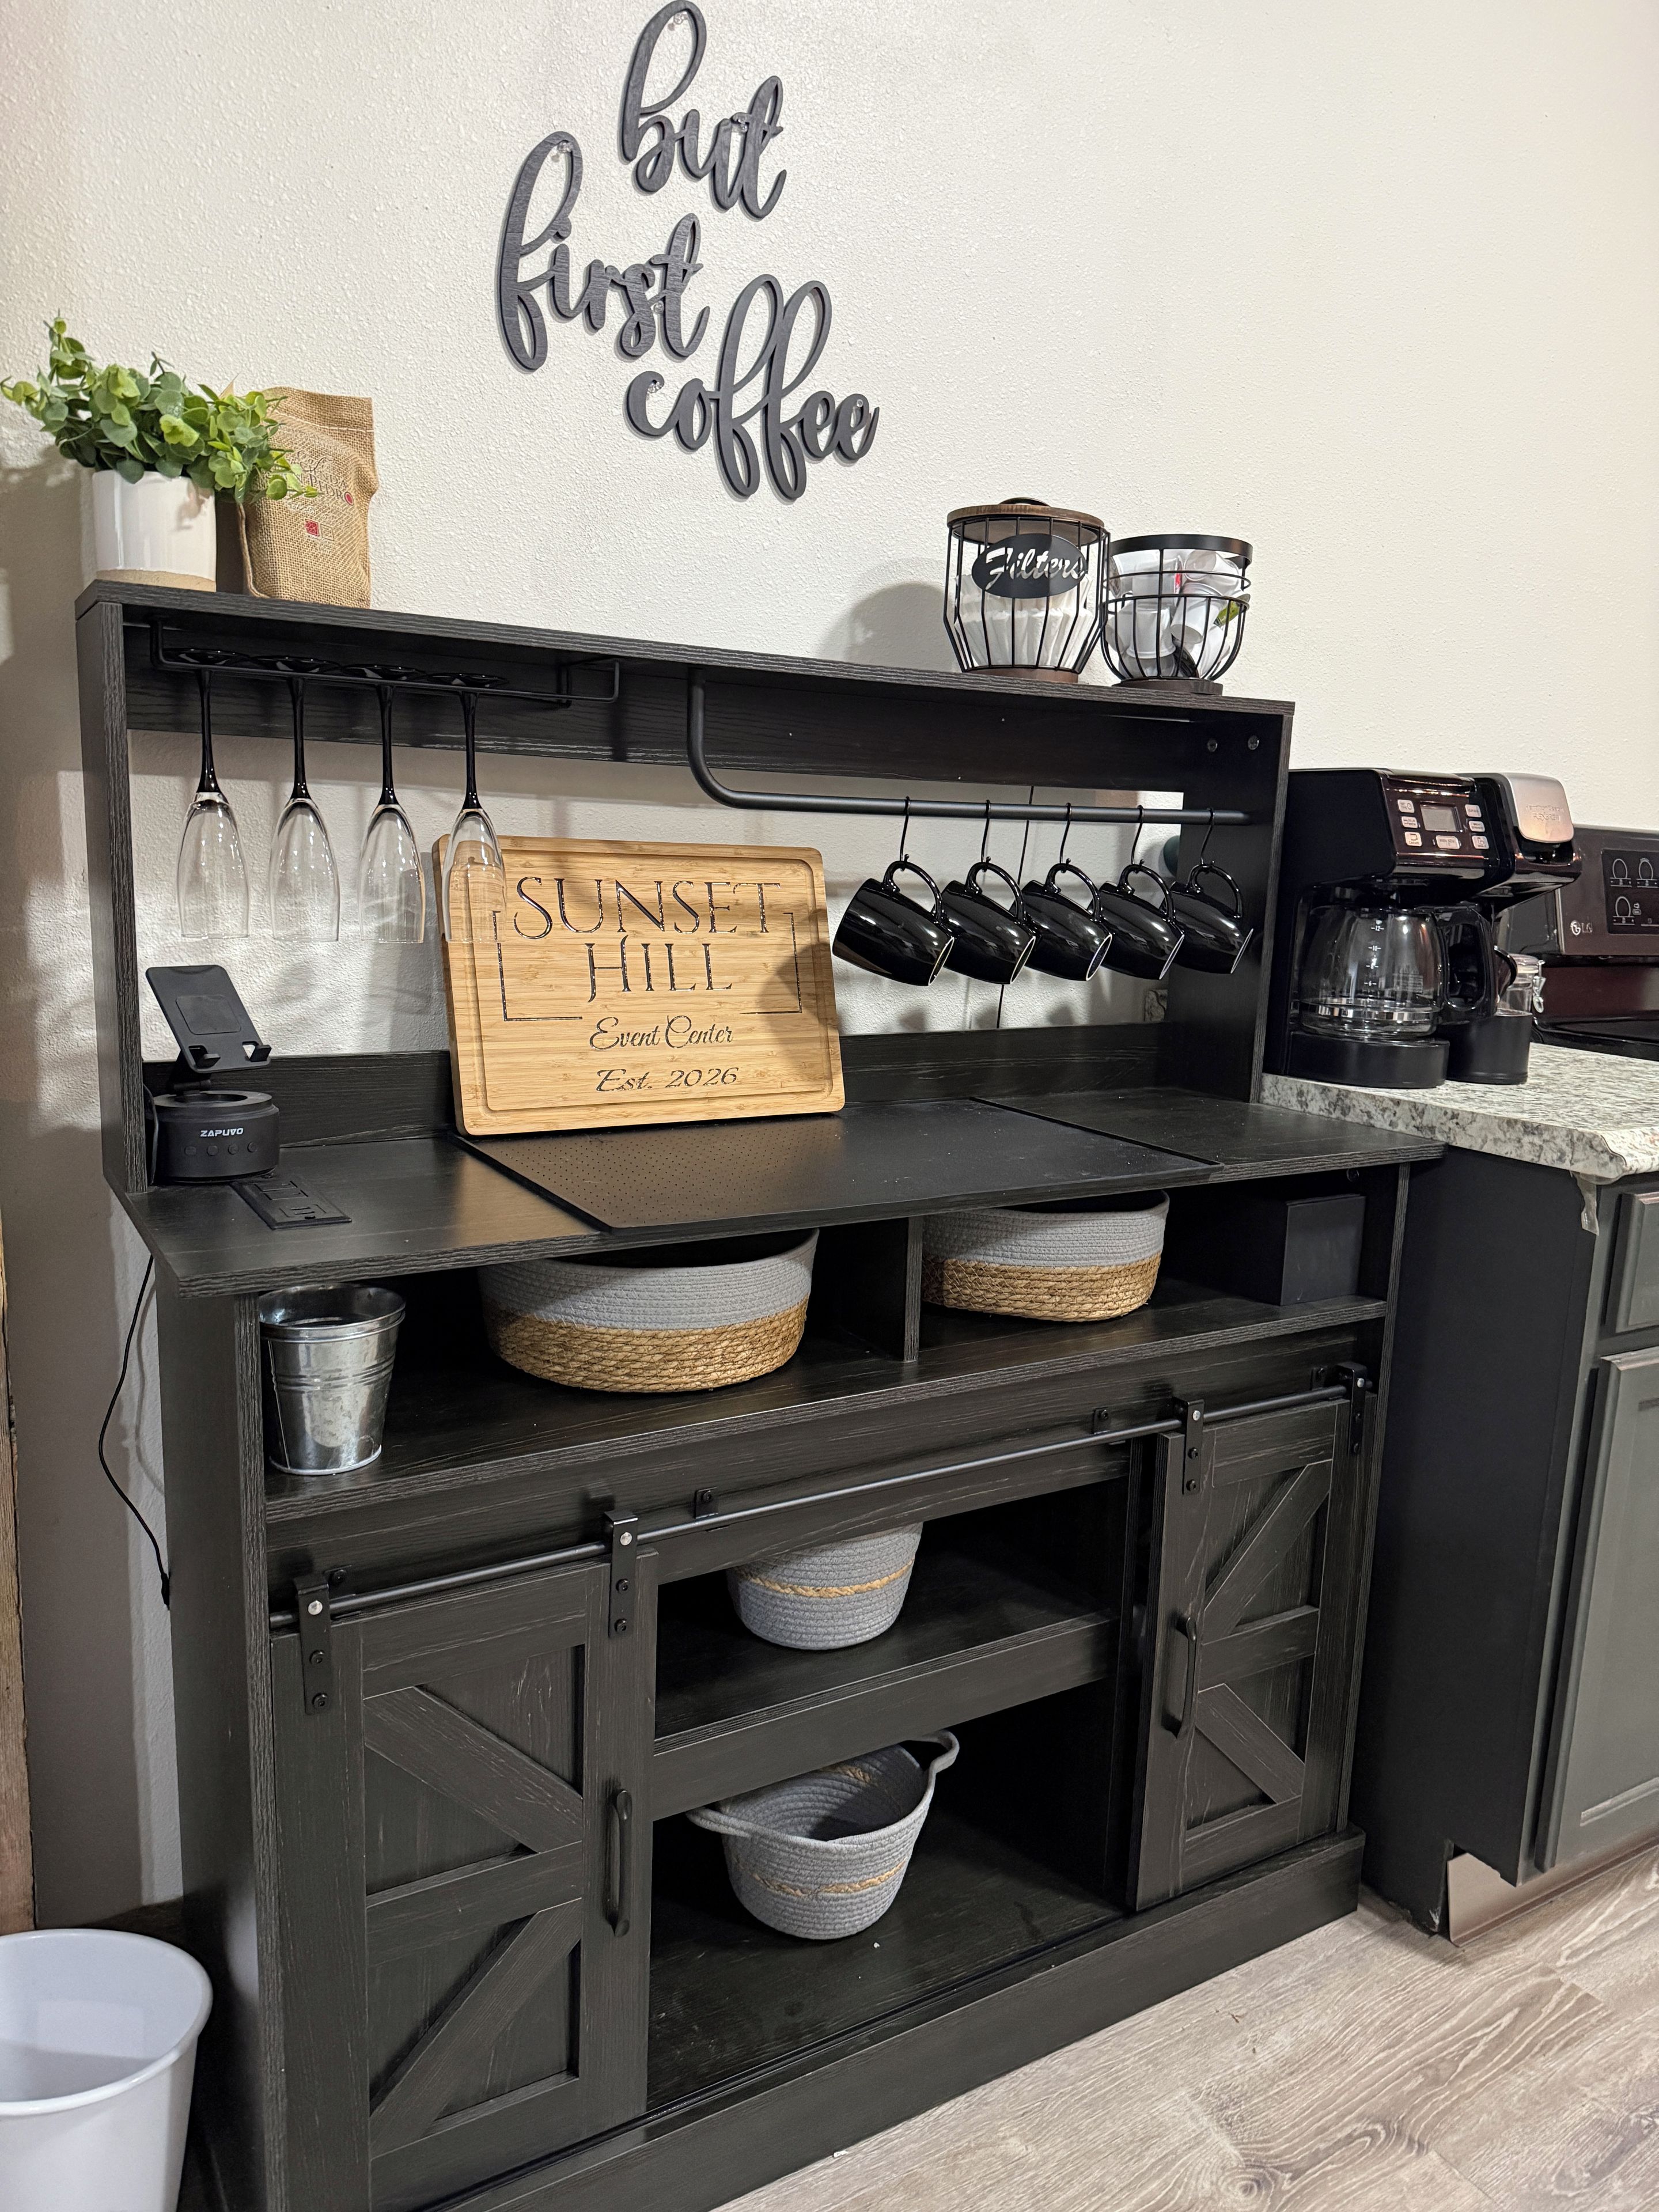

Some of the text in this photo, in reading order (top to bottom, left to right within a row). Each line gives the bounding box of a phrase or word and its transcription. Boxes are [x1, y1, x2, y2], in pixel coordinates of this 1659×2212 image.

[620, 0, 787, 219] but
[498, 131, 710, 371] first
[626, 274, 880, 499] coffee
[985, 547, 1085, 590] Filters
[513, 876, 781, 940] SUNSET
[585, 934, 733, 1003] HILL
[589, 1015, 734, 1051] Event Center
[596, 1067, 738, 1092] Est. 2026
[200, 1127, 244, 1137] ZAPUVO
